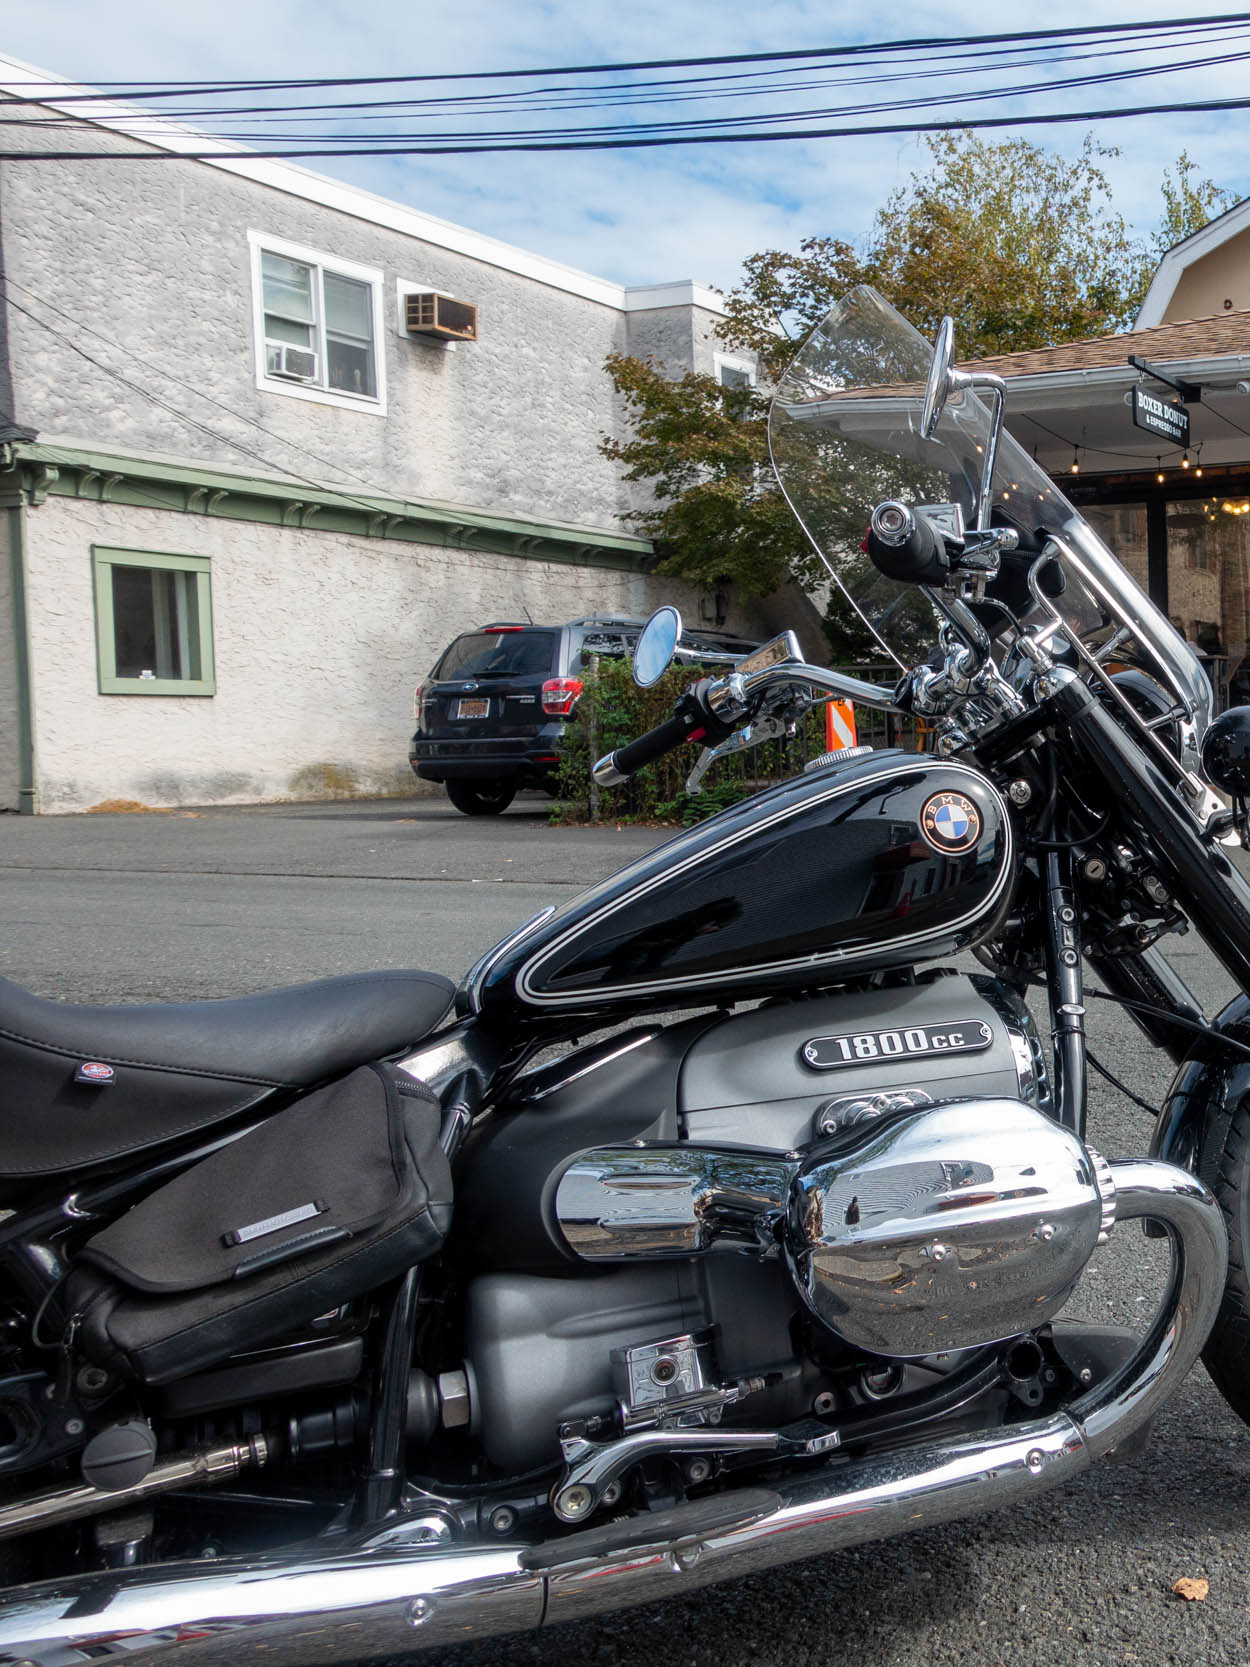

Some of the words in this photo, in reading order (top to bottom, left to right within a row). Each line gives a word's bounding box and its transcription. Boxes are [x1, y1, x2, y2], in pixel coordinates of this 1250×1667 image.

[1138, 391, 1163, 417] BOXER
[1164, 405, 1188, 429] DONUT
[1150, 415, 1173, 434] ESPRESSO
[927, 795, 972, 815] BMW
[835, 1029, 965, 1061] 1800cc
